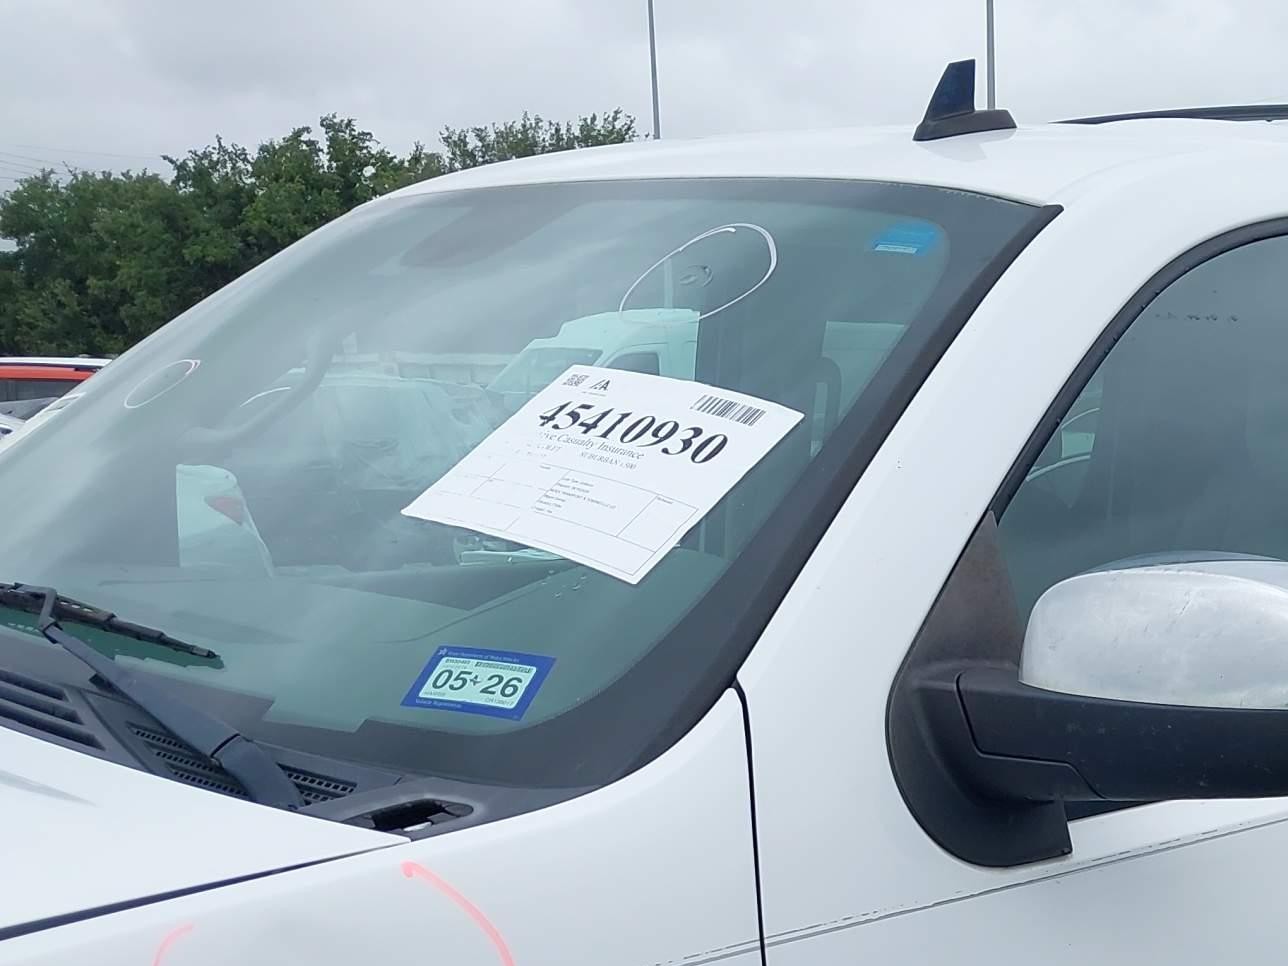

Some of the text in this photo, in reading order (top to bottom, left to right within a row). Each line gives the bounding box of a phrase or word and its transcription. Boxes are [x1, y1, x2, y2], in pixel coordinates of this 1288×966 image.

[538, 400, 729, 464] 45410930
[557, 433, 594, 450] Casualty
[597, 441, 645, 460] Insurance
[432, 669, 523, 698] 05 26
